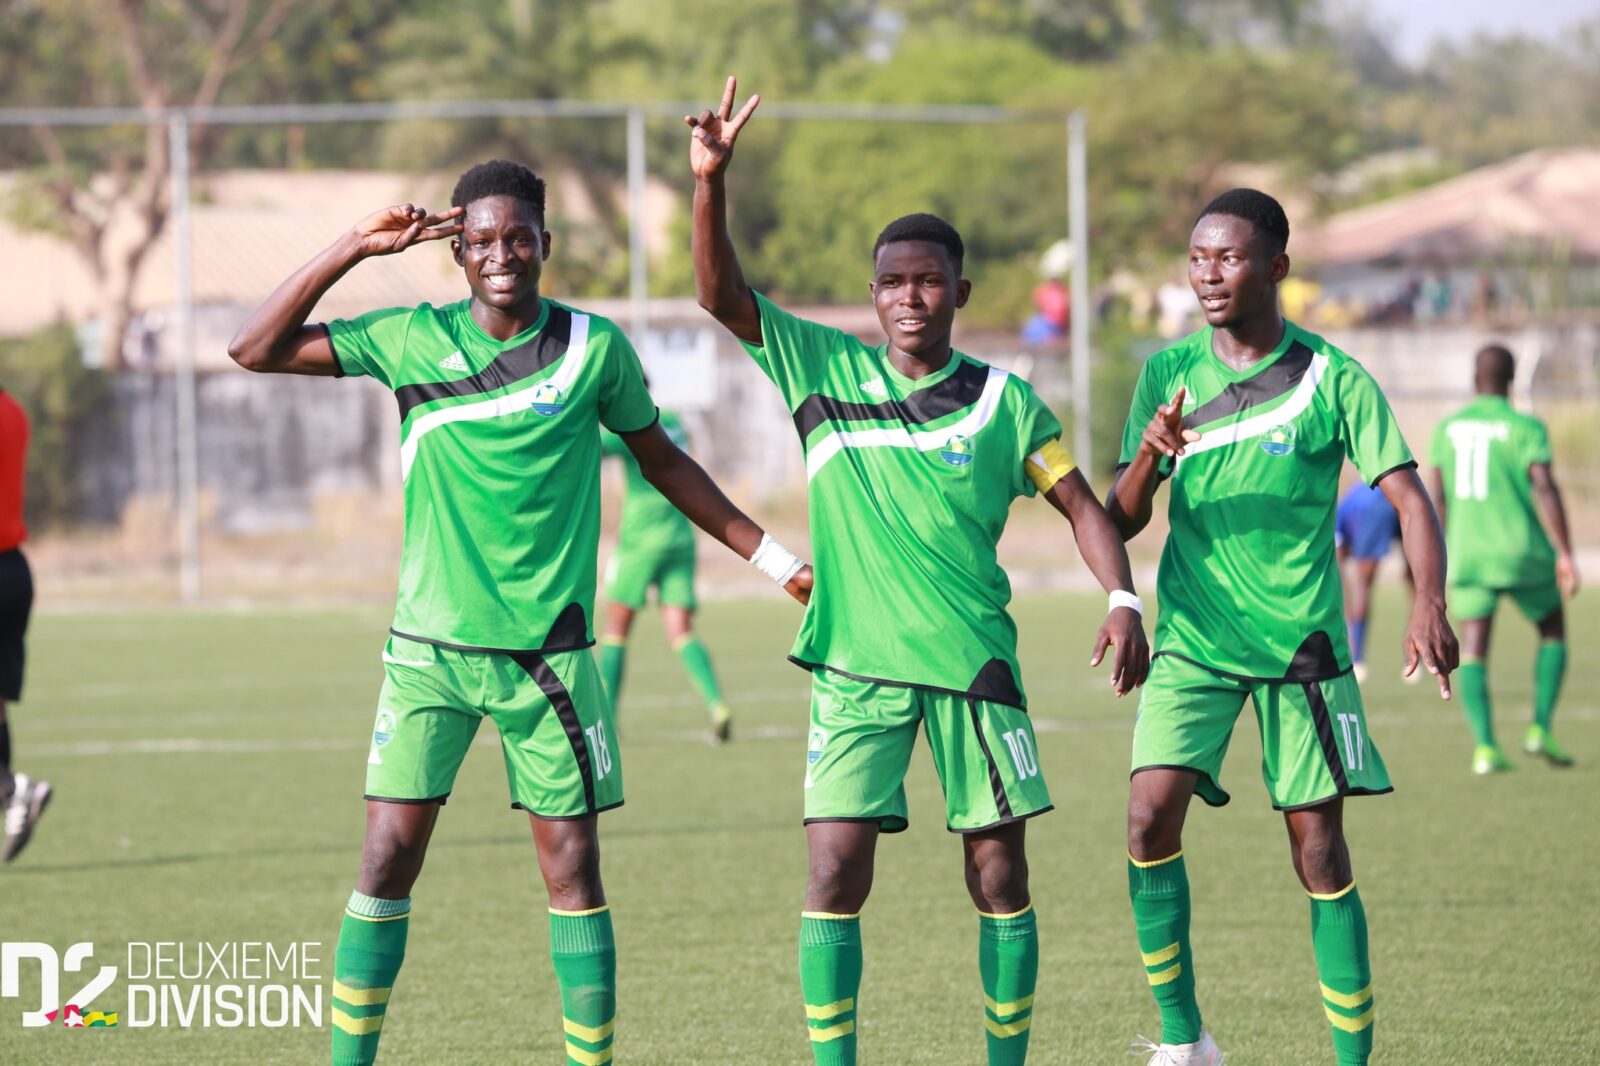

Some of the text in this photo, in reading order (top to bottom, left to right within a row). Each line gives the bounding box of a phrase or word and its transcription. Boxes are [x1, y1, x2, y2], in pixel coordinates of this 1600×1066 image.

[1453, 436, 1490, 500] 11
[585, 719, 612, 781] 18
[1002, 728, 1038, 781] 10
[1337, 712, 1363, 771] 17
